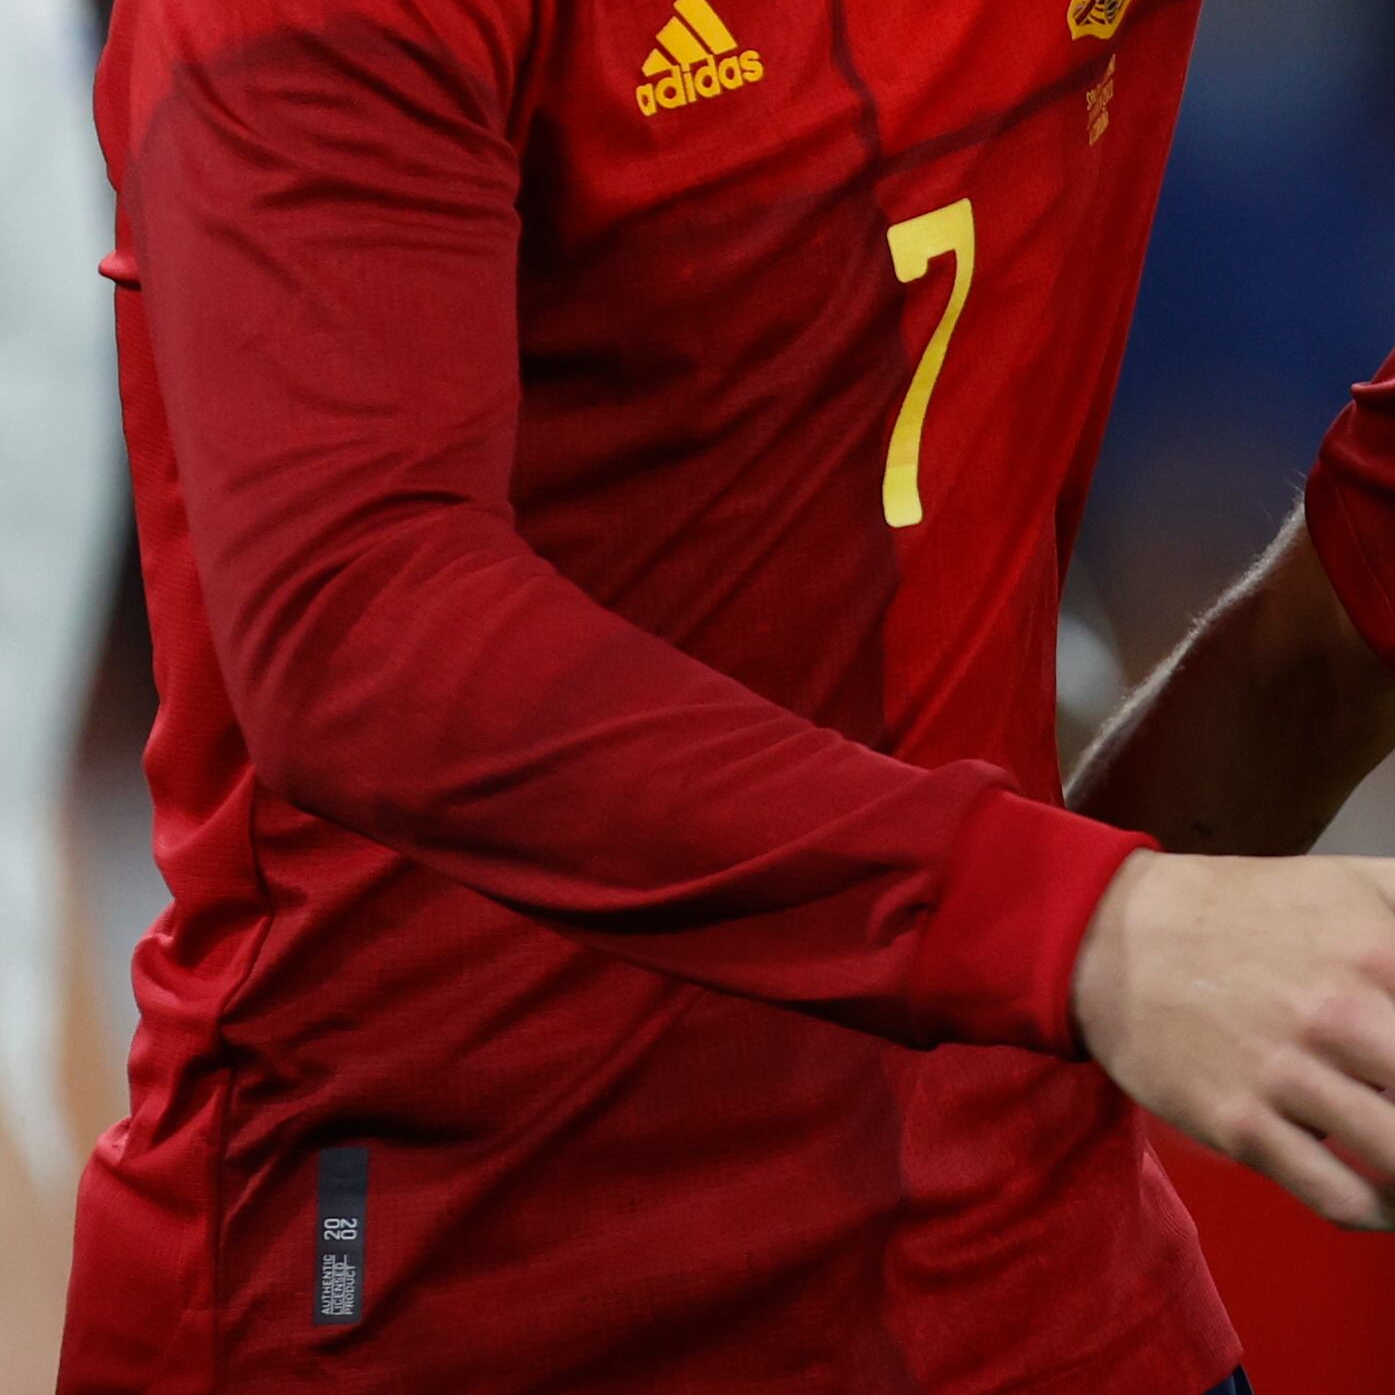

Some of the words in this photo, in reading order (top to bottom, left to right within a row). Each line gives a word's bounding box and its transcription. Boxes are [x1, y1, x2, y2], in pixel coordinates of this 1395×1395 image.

[636, 50, 763, 116] adidas
[883, 198, 975, 528] 7
[324, 1218, 340, 1240] 20
[320, 1254, 333, 1315] AUTHENTIC
[344, 1265, 356, 1315] PRODUCT
